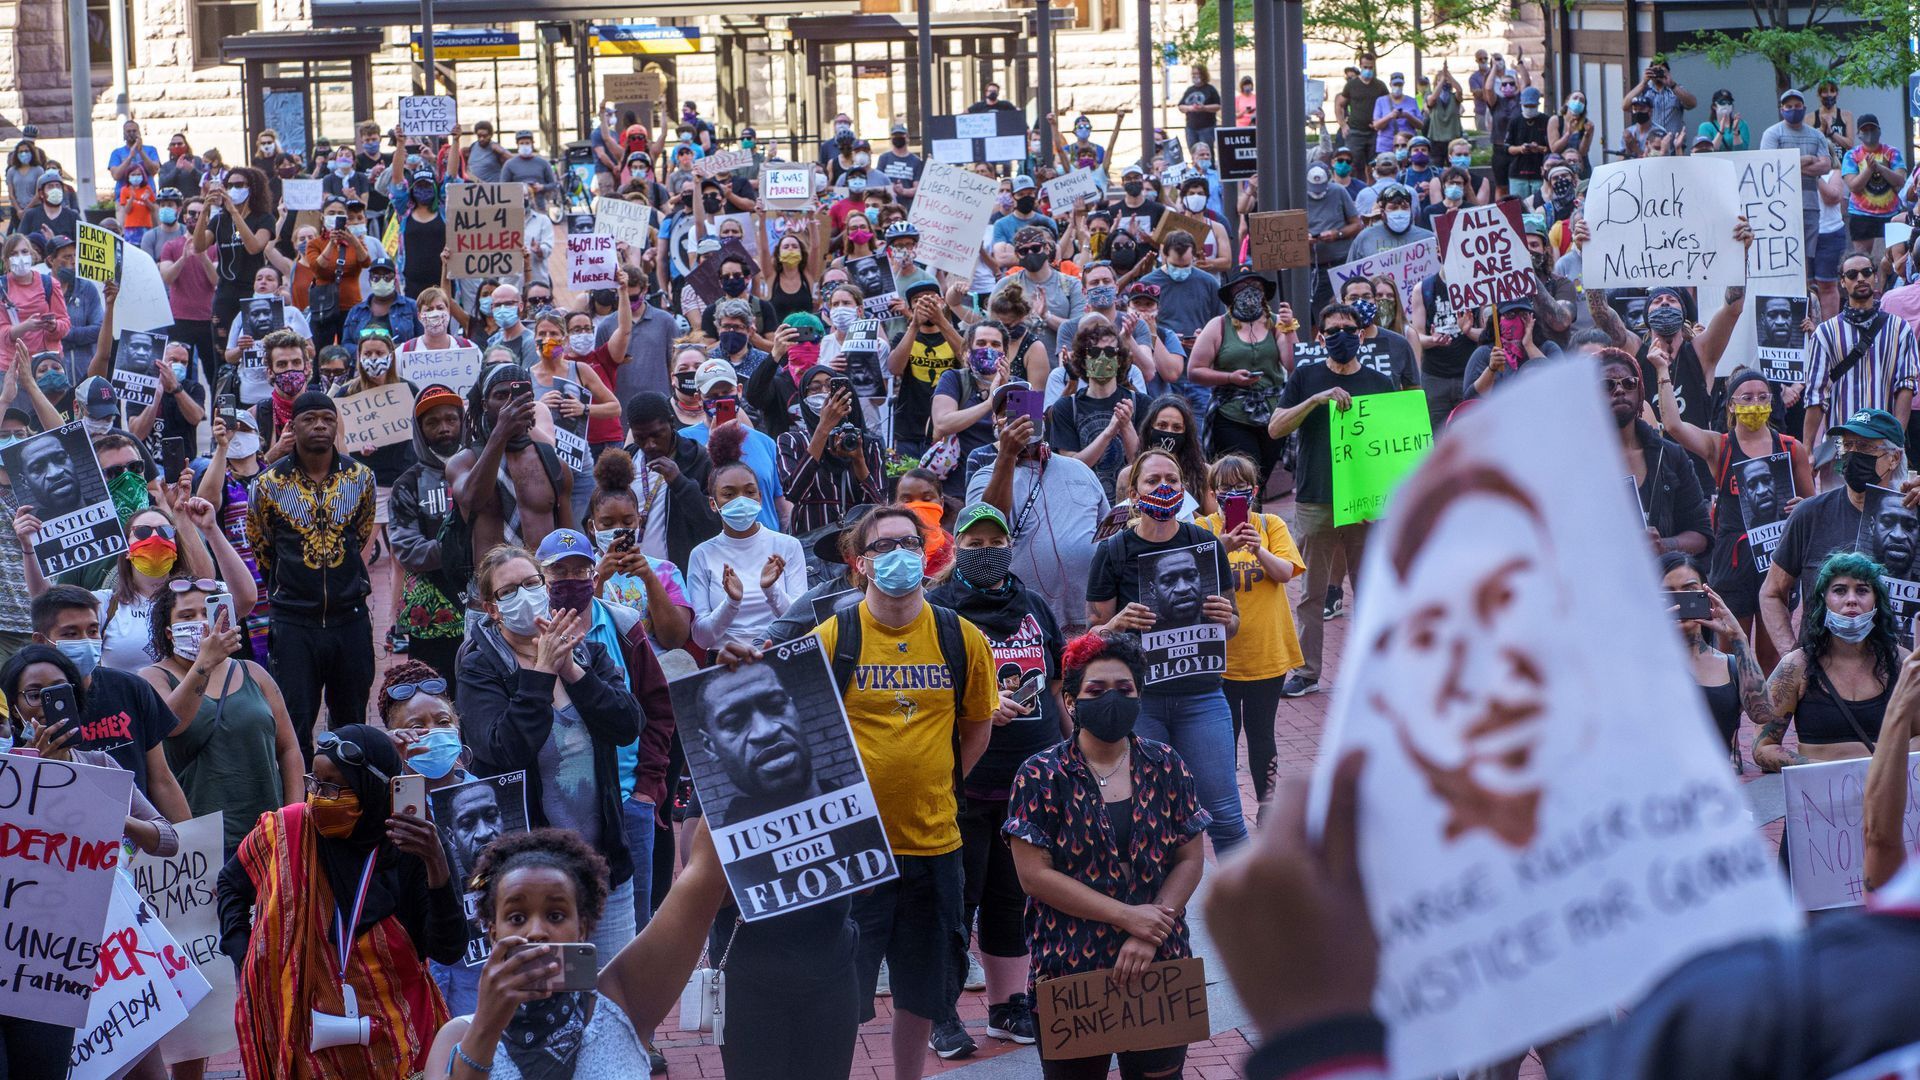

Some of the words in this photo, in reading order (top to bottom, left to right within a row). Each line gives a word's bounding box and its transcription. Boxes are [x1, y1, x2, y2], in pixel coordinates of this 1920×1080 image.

[433, 38, 480, 46] GOVERNMENT
[481, 37, 504, 45] PLAZA
[405, 97, 447, 108] BLACK
[405, 108, 447, 119] LIVES
[402, 120, 451, 133] MATTER
[1224, 136, 1251, 145] BLACK
[770, 172, 779, 184] HE
[783, 173, 803, 182] WAS
[929, 163, 952, 178] FOR
[959, 172, 997, 196] BLACK
[1054, 173, 1088, 191] ENOUGH
[463, 184, 511, 207] JAIL
[769, 186, 806, 196] MURDERED
[920, 181, 981, 208] LIBERATION
[1597, 165, 1684, 231] Black
[917, 195, 973, 223] THROUGH
[455, 210, 486, 232] ALL
[494, 208, 507, 228] 4
[911, 213, 958, 235] SOCIALIST
[1256, 218, 1279, 235] NO
[1462, 209, 1500, 232] ALL
[79, 224, 107, 246] BLACK
[457, 231, 524, 253] KILLER
[1256, 228, 1307, 246] JUSTICE
[1460, 227, 1512, 259] COPS
[1643, 223, 1700, 250] Lives
[79, 243, 106, 264] LIVES
[1271, 243, 1284, 253] NO
[465, 253, 513, 275] COPS
[575, 255, 585, 266] it
[588, 256, 605, 265] was
[1260, 250, 1304, 269] PEACE
[1379, 253, 1401, 269] will
[1404, 259, 1433, 280] Fear
[1473, 254, 1512, 279] ARE
[1448, 267, 1537, 311] BASTARDS
[409, 351, 465, 366] ARREST
[1761, 349, 1801, 360] JUSTICE
[116, 371, 155, 387] JUSTICE
[412, 366, 459, 380] CHARGE
[1763, 367, 1803, 381] FLOYD
[67, 421, 82, 432] CAIR
[357, 411, 381, 425] FOR
[1340, 420, 1365, 441] IS
[36, 505, 109, 544] JUSTICE
[65, 531, 90, 547] FOR
[1202, 543, 1215, 551] CAIR
[43, 534, 123, 573] FLOYD
[791, 638, 816, 653] CAIR
[1011, 637, 1040, 648] ALL
[1149, 626, 1219, 650] JUSTICE
[1172, 646, 1195, 657] FOR
[855, 663, 954, 691] VIKINGS
[1150, 655, 1223, 681] FLOYD
[507, 772, 523, 783] CAIR
[726, 793, 863, 861] JUSTICE
[782, 841, 828, 867] FOR
[1808, 829, 1852, 877] NO
[744, 848, 889, 915] FLOYD
[166, 882, 215, 919] MAS
[5, 922, 103, 972] UNCLES
[1051, 980, 1098, 1015] KILL
[1103, 975, 1121, 999] A
[1126, 966, 1182, 999] COP
